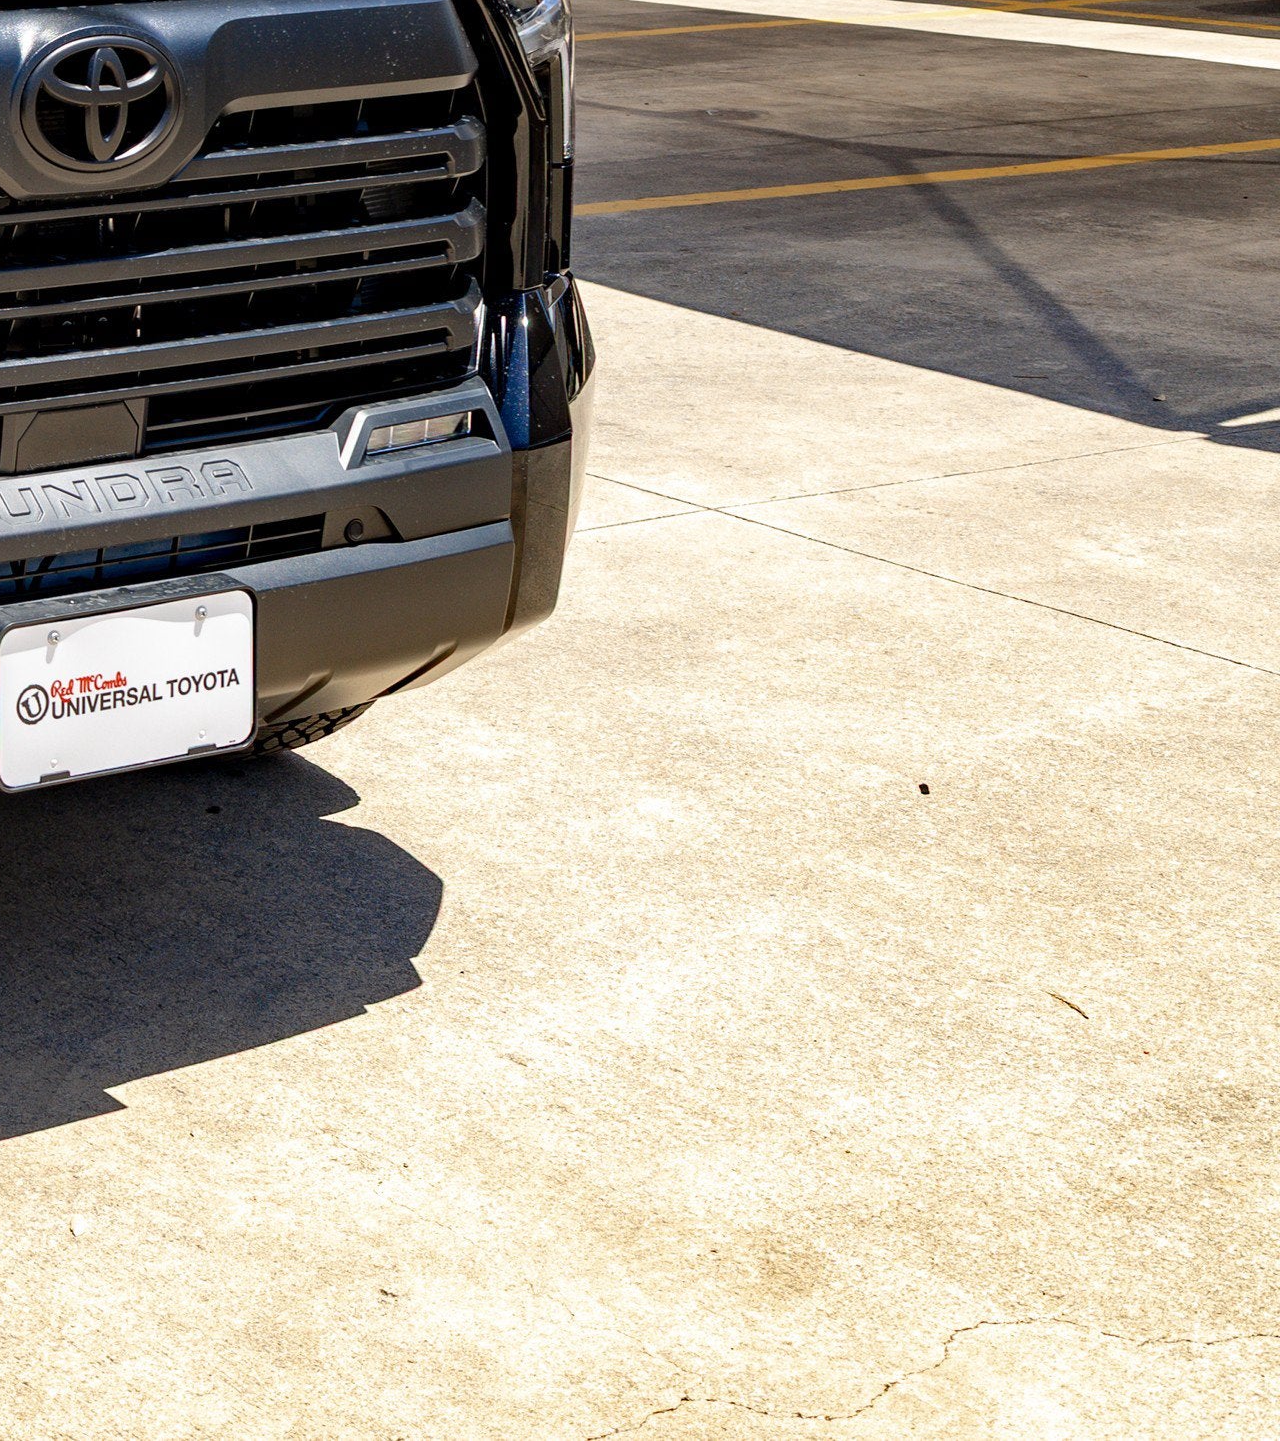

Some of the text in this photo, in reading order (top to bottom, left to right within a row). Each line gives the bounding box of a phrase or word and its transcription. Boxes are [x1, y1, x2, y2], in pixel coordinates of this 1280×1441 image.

[51, 671, 128, 703] Red McCombs
[51, 668, 241, 720] UNIVERSAL TOYOTA
